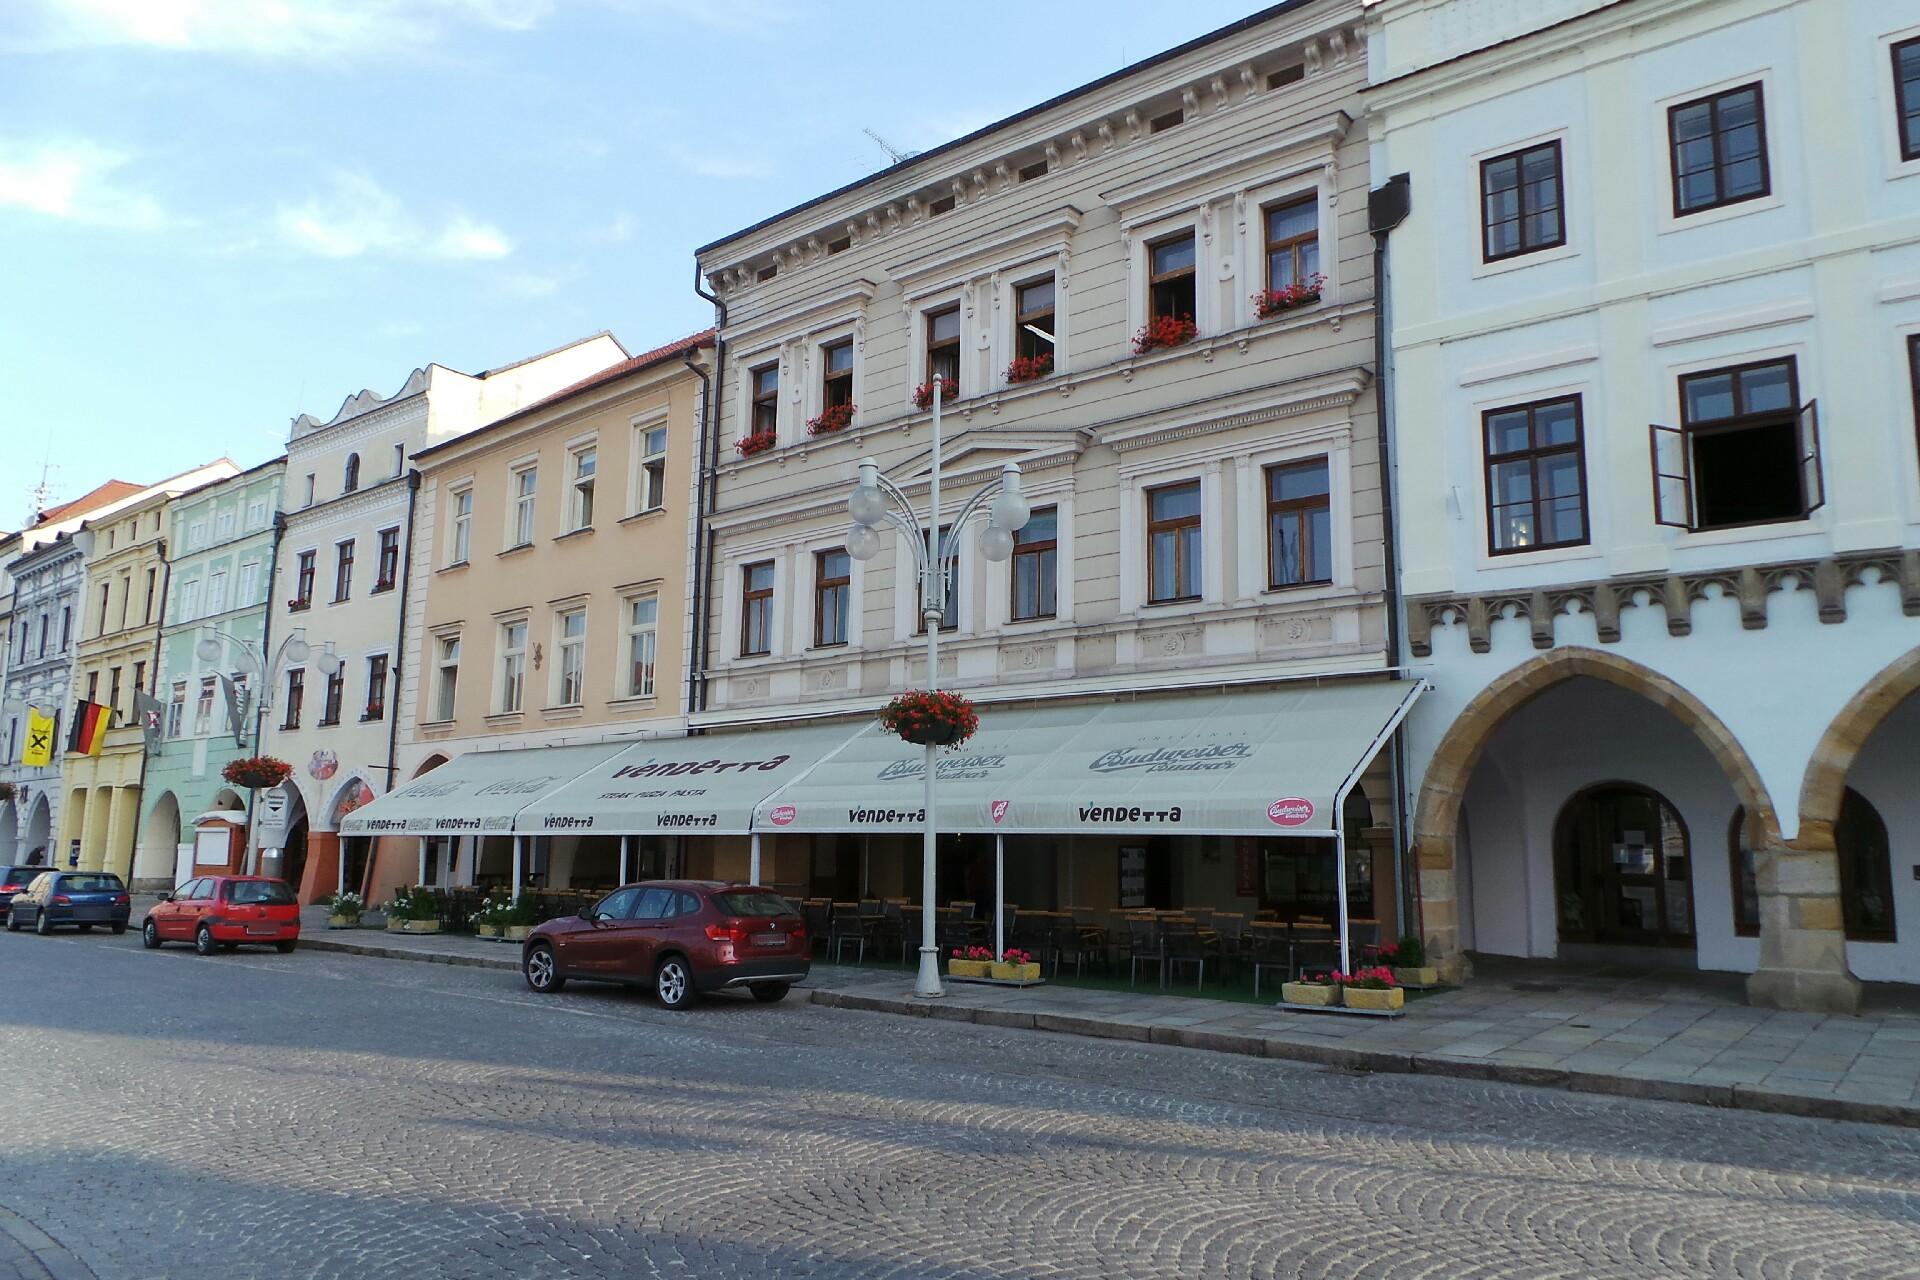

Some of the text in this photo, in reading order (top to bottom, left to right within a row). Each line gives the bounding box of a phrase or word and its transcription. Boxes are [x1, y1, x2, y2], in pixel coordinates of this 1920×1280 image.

[1089, 743, 1253, 773] Budweiser
[1145, 760, 1235, 773] Budvar
[598, 792, 633, 800] STEAK
[669, 789, 708, 798] PASTA
